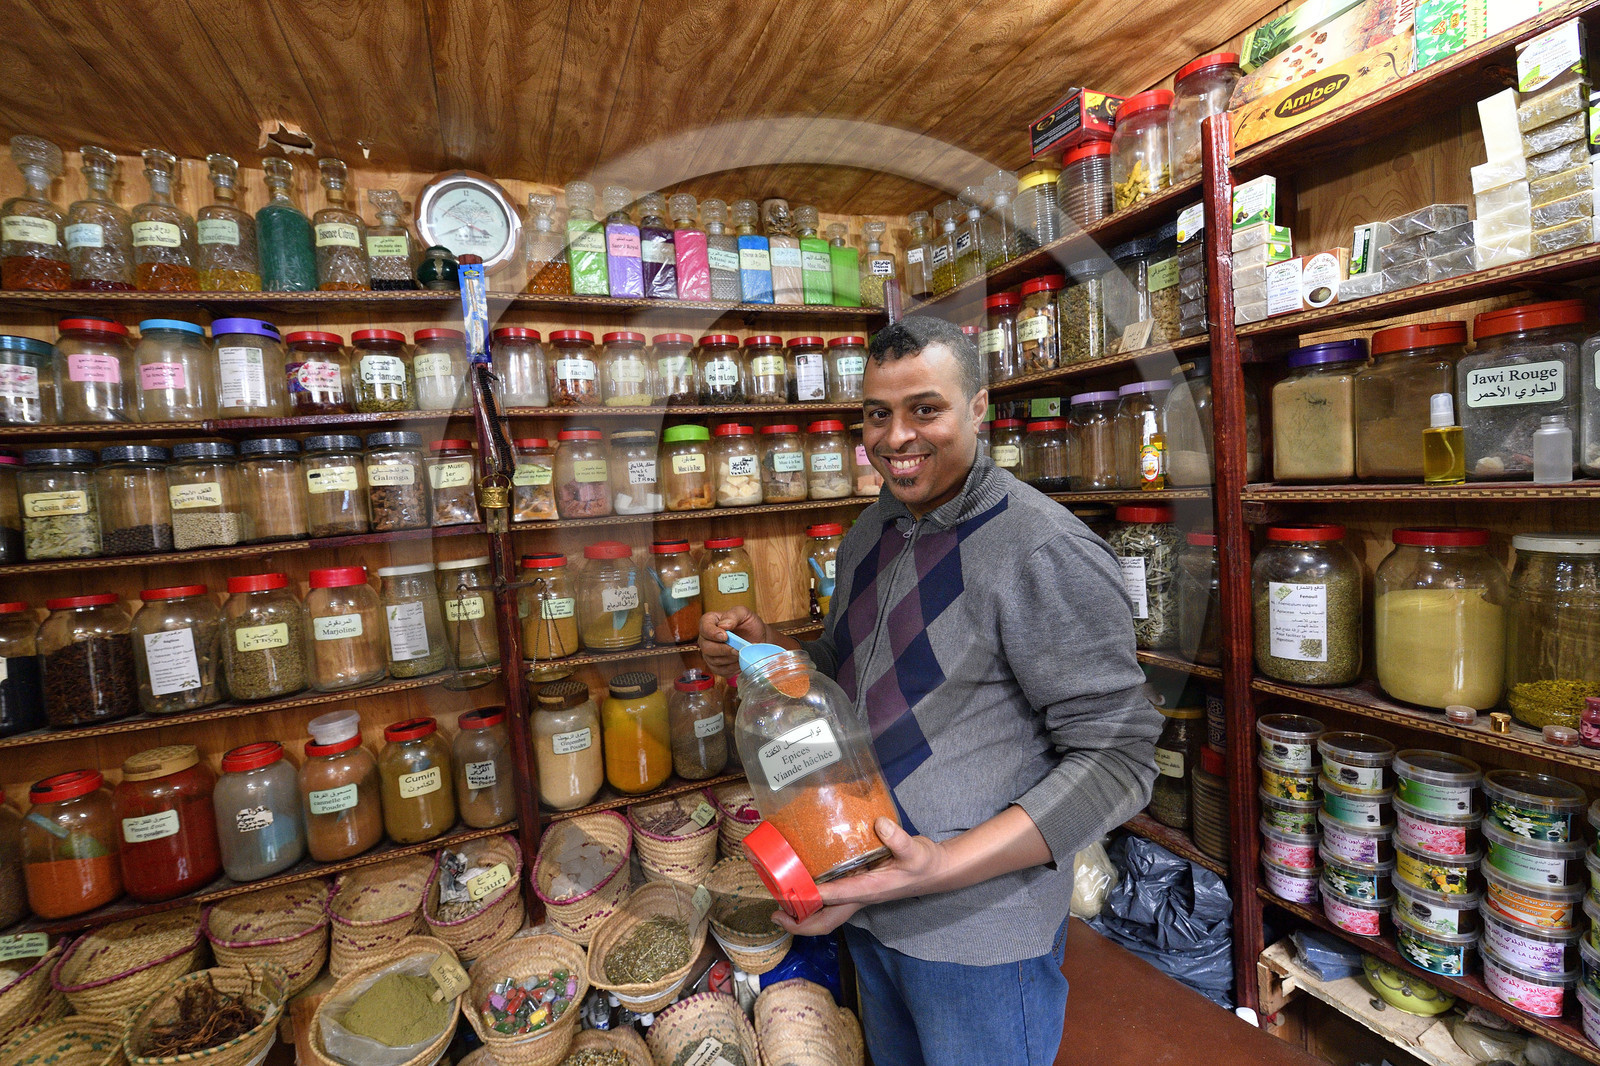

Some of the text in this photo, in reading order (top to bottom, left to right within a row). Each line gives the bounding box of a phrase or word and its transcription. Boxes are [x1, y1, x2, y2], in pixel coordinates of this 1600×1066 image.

[1278, 77, 1347, 114] Amber
[318, 228, 356, 240] Essence Citron
[724, 374, 736, 382] Long
[1472, 368, 1558, 385] Jawi Rouge
[1474, 382, 1557, 402] الجاوي الأحمر
[322, 627, 356, 636] Marjoline
[765, 726, 822, 758] توابل الكفتة
[782, 746, 811, 765] Epices
[773, 750, 833, 783] Viande hâchée
[405, 772, 436, 784] Cumin
[313, 797, 341, 806] cannelle
[473, 875, 506, 897] Cauri
[437, 966, 456, 994] Daphn
